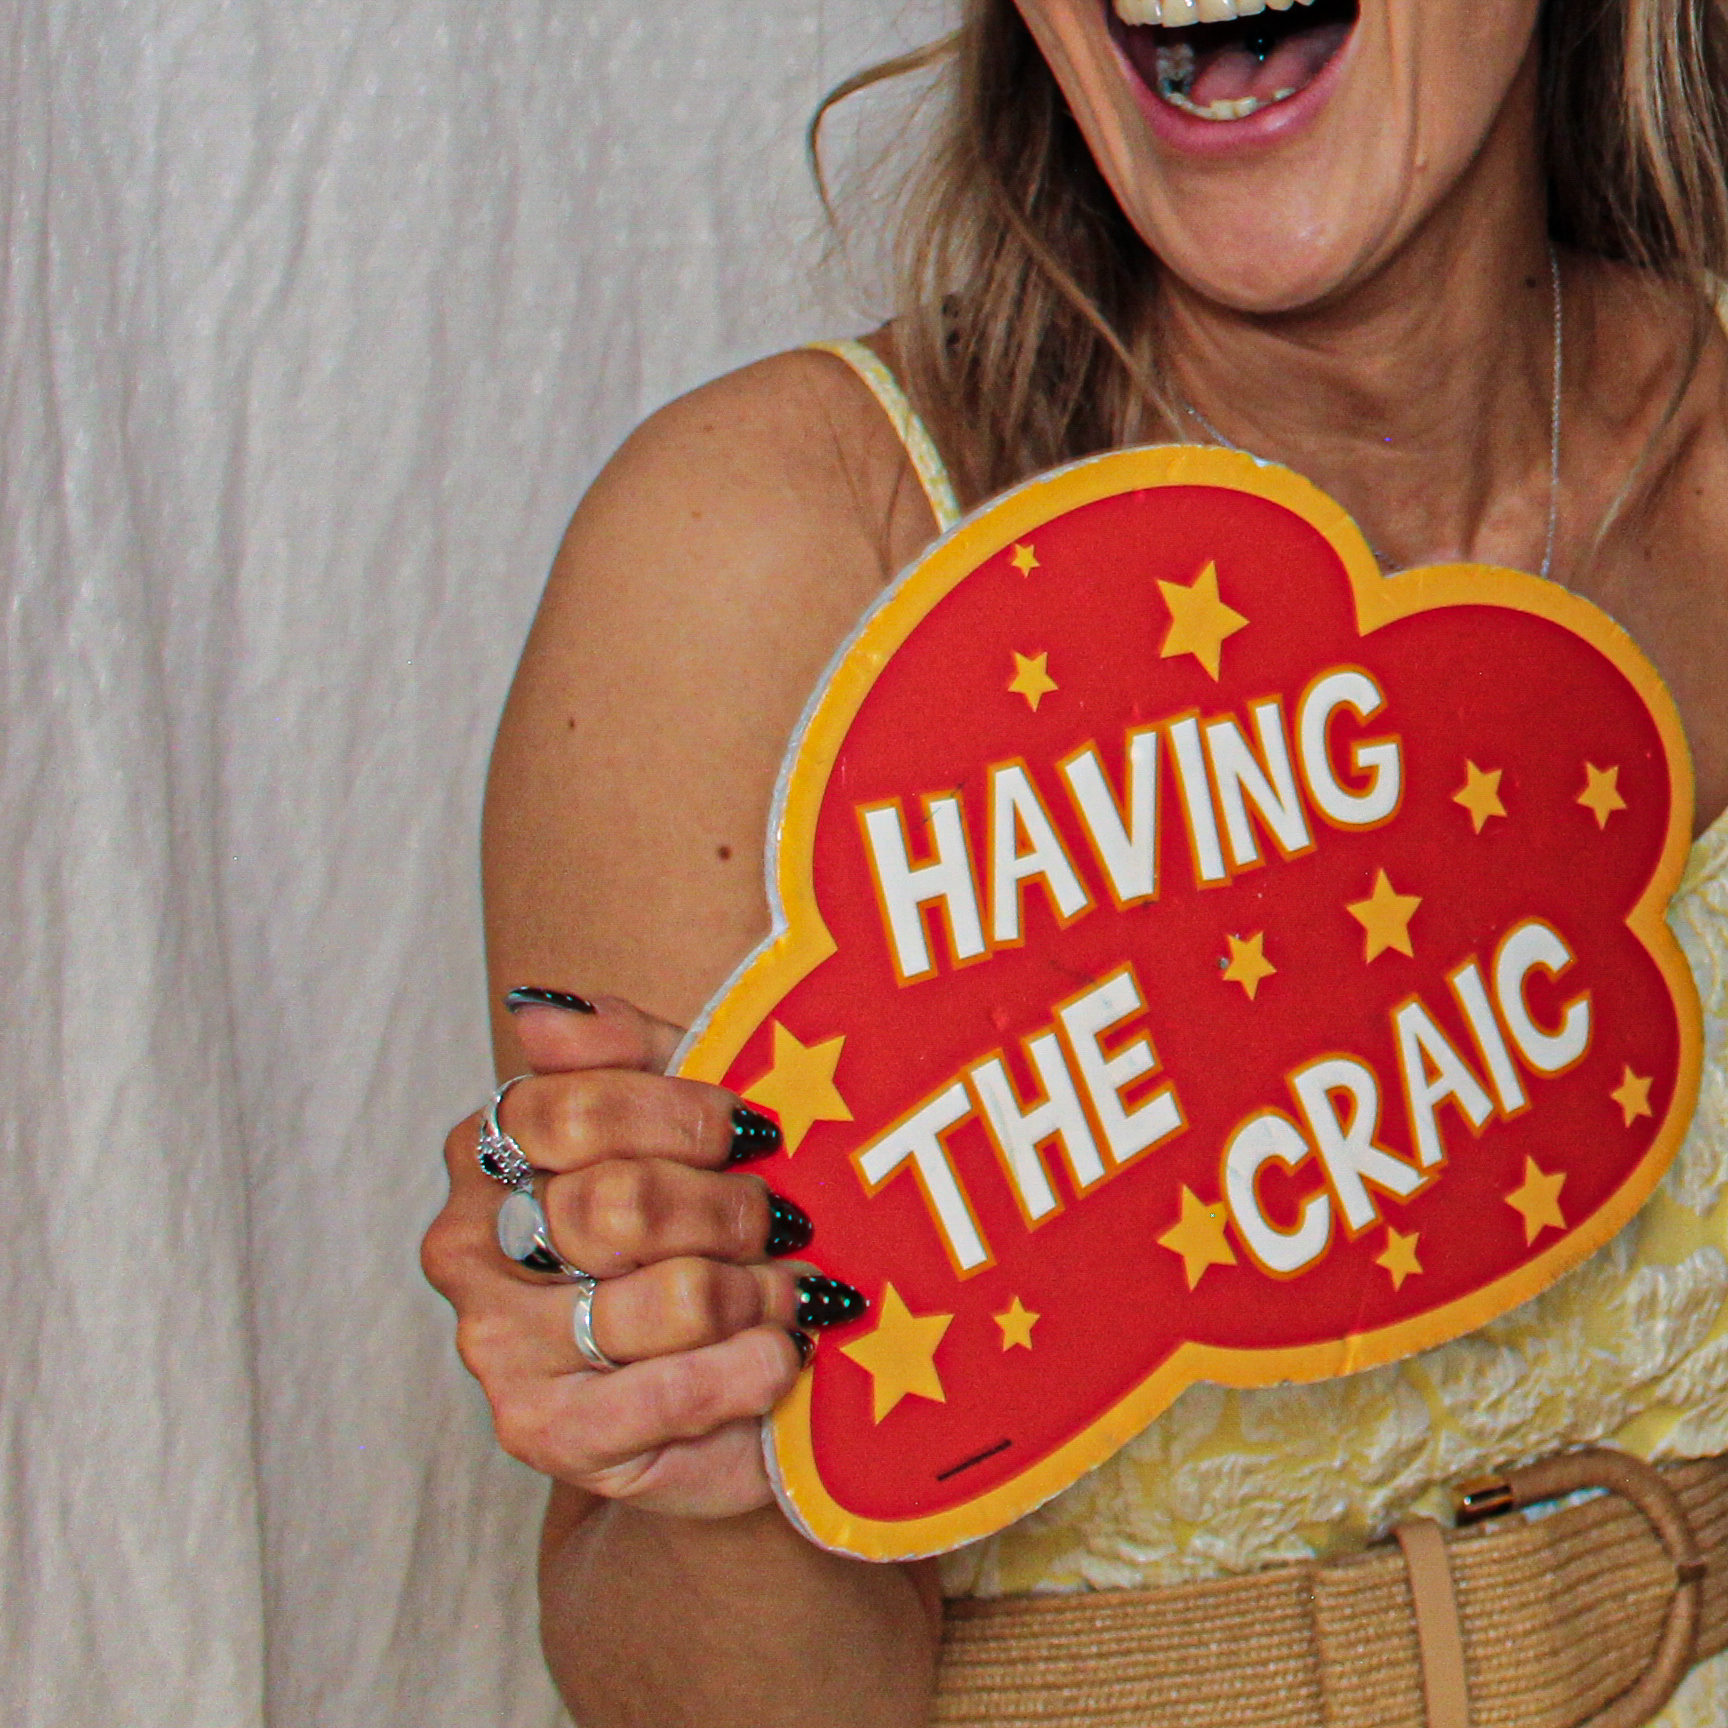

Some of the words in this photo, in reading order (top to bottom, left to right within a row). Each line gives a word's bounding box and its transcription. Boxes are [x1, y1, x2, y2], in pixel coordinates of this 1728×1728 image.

[863, 671, 1401, 978] HAVING
[857, 971, 1184, 1272] THE
[1221, 923, 1590, 1274] CRAIC
